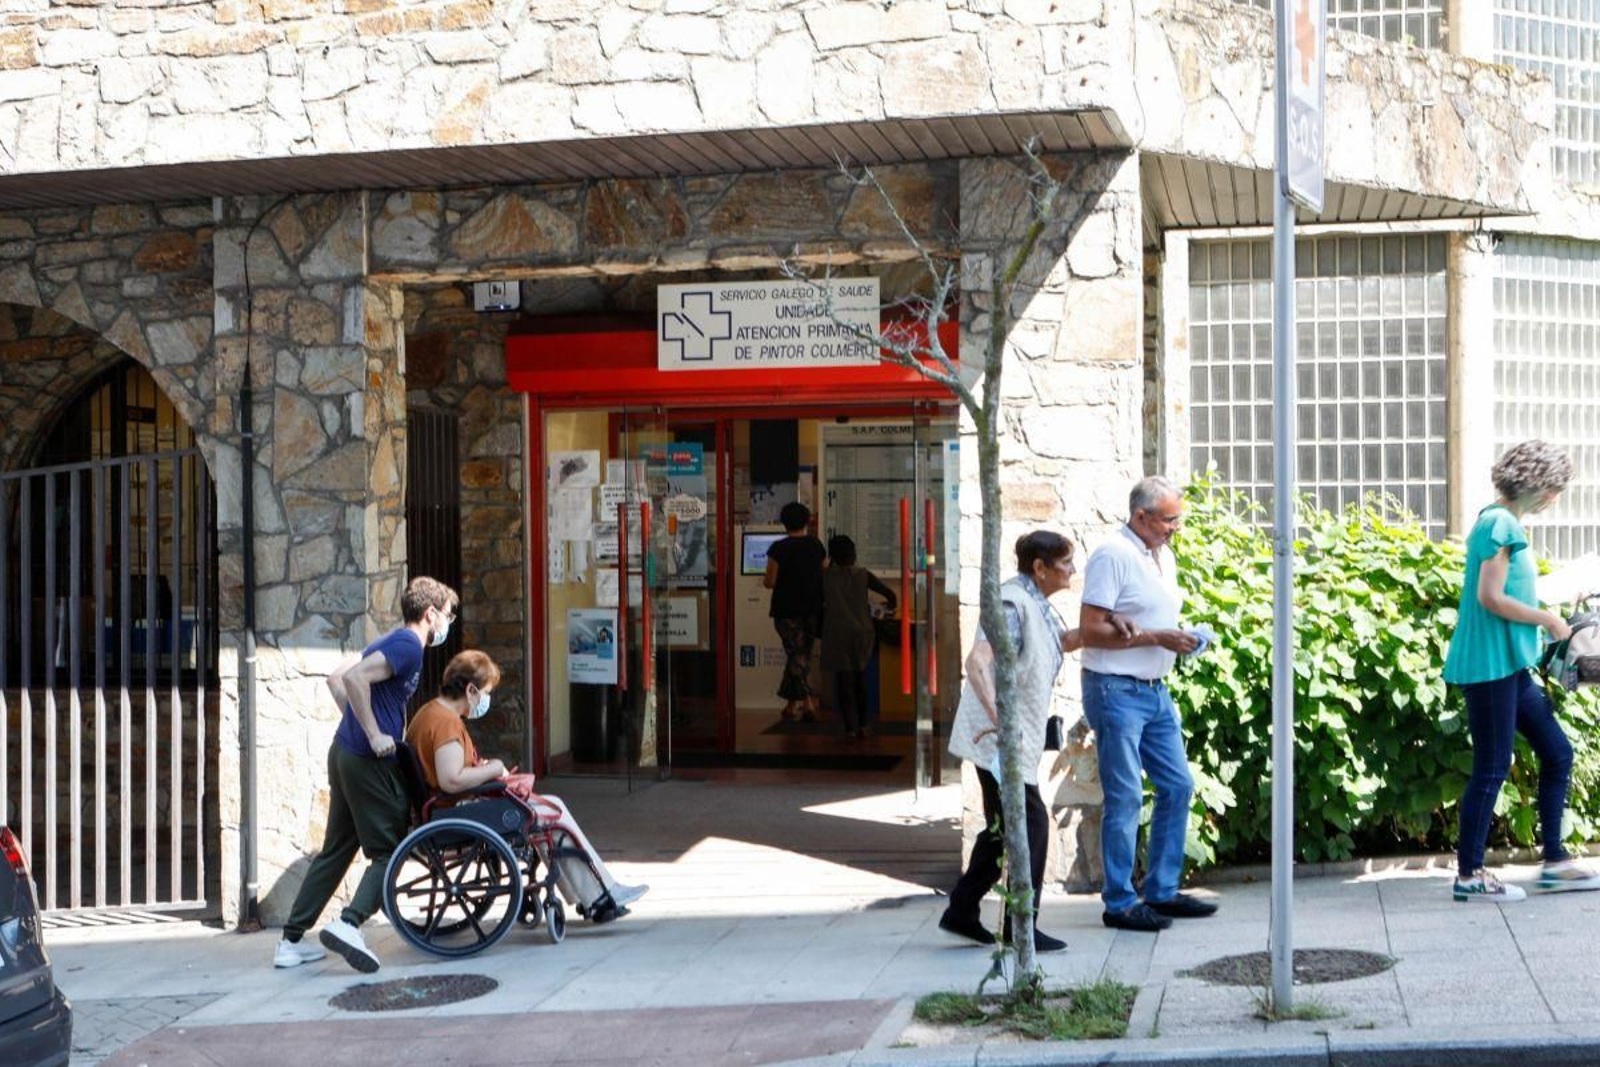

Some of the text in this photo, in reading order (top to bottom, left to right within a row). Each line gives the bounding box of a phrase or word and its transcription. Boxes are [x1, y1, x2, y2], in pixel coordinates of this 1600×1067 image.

[720, 285, 873, 301] SERVICIO GALEGO D SAUDE
[736, 324, 801, 340] ATENCION
[735, 343, 875, 360] DE PINTOR COLMEIRO
